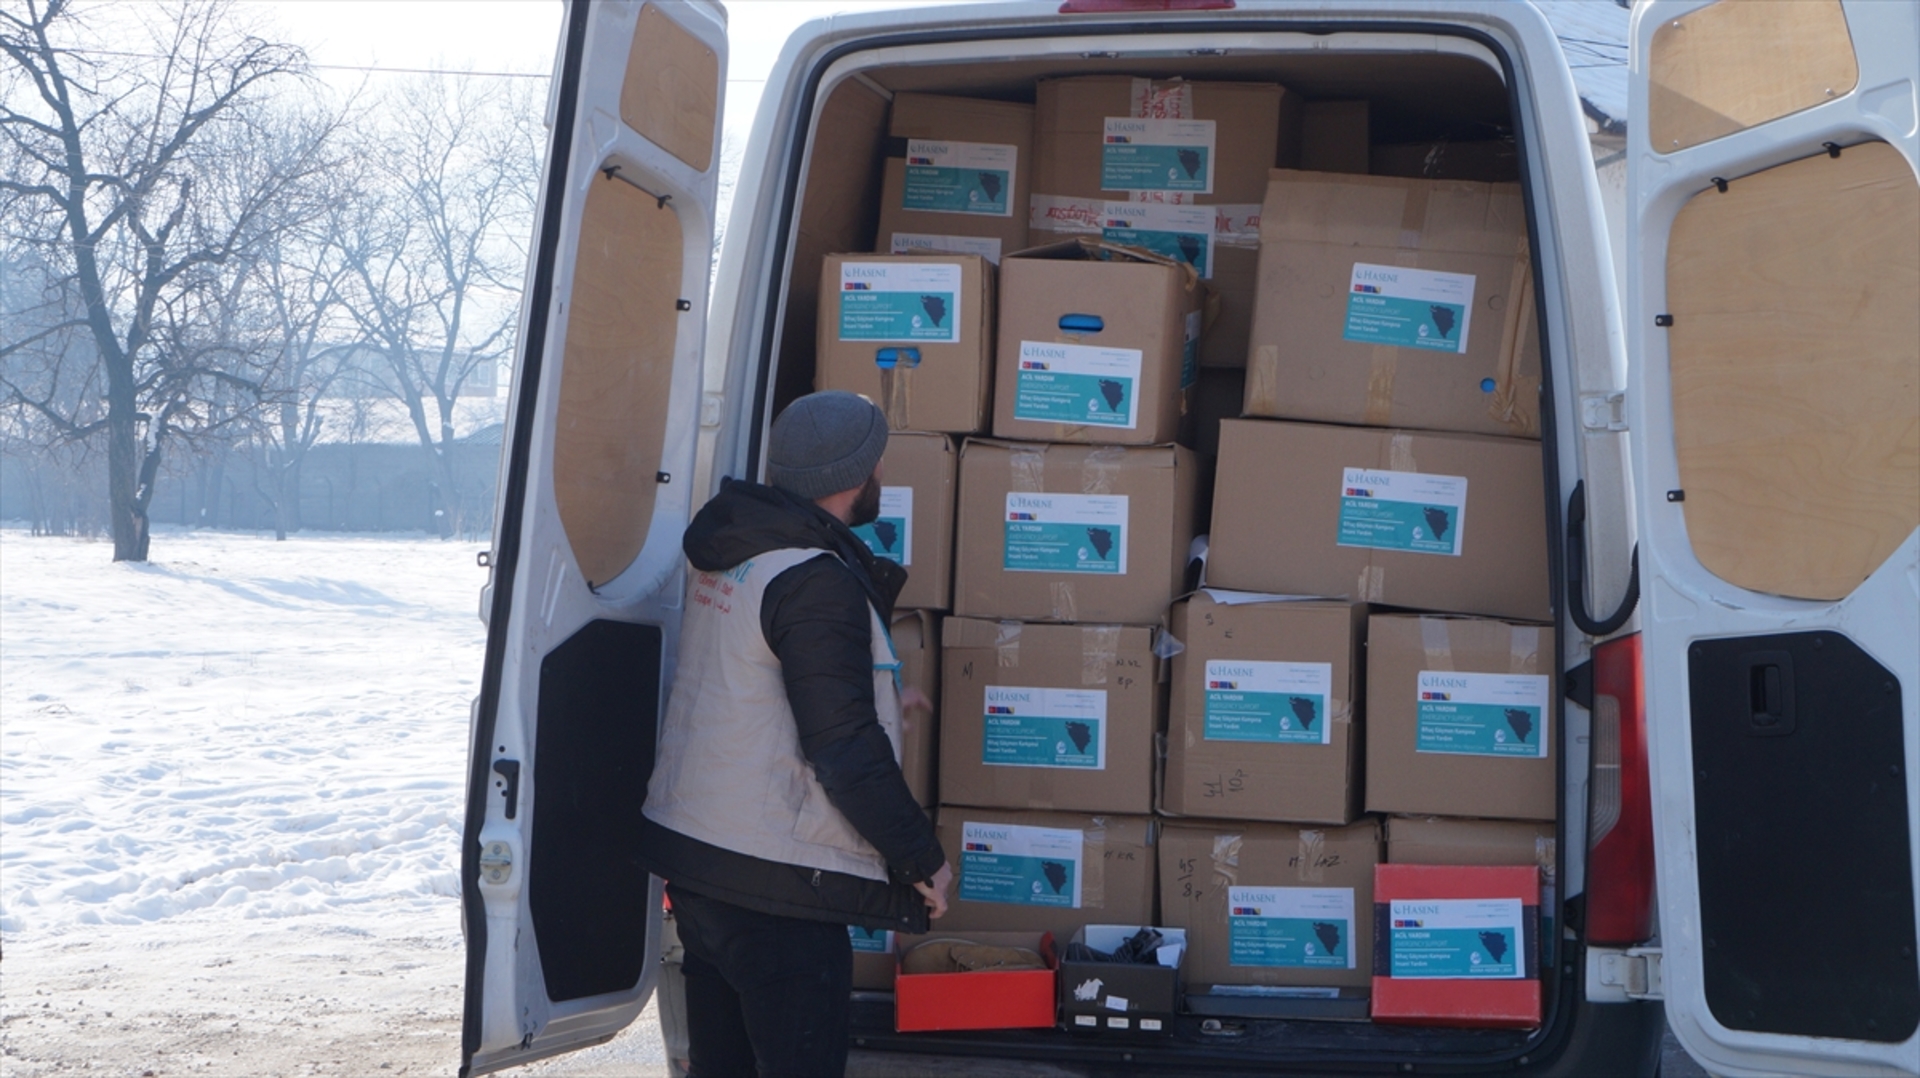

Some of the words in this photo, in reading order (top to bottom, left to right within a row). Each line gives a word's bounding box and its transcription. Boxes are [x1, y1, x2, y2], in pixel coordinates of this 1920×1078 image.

[1114, 122, 1146, 132] HASENE
[917, 144, 948, 154] HASENE
[1115, 206, 1146, 217] HASENE
[852, 268, 886, 277] HASENE
[1363, 270, 1399, 283] HASENE
[1031, 347, 1066, 359] HASENE
[1355, 474, 1390, 486] HASENE
[1018, 498, 1052, 508] HASENE
[1218, 666, 1253, 677] HASENE
[1431, 677, 1467, 688] HASENE
[996, 691, 1030, 702] HASENE
[974, 828, 1008, 840] HASENE
[1241, 892, 1276, 903] HASENE
[1402, 904, 1439, 915] HASENE
